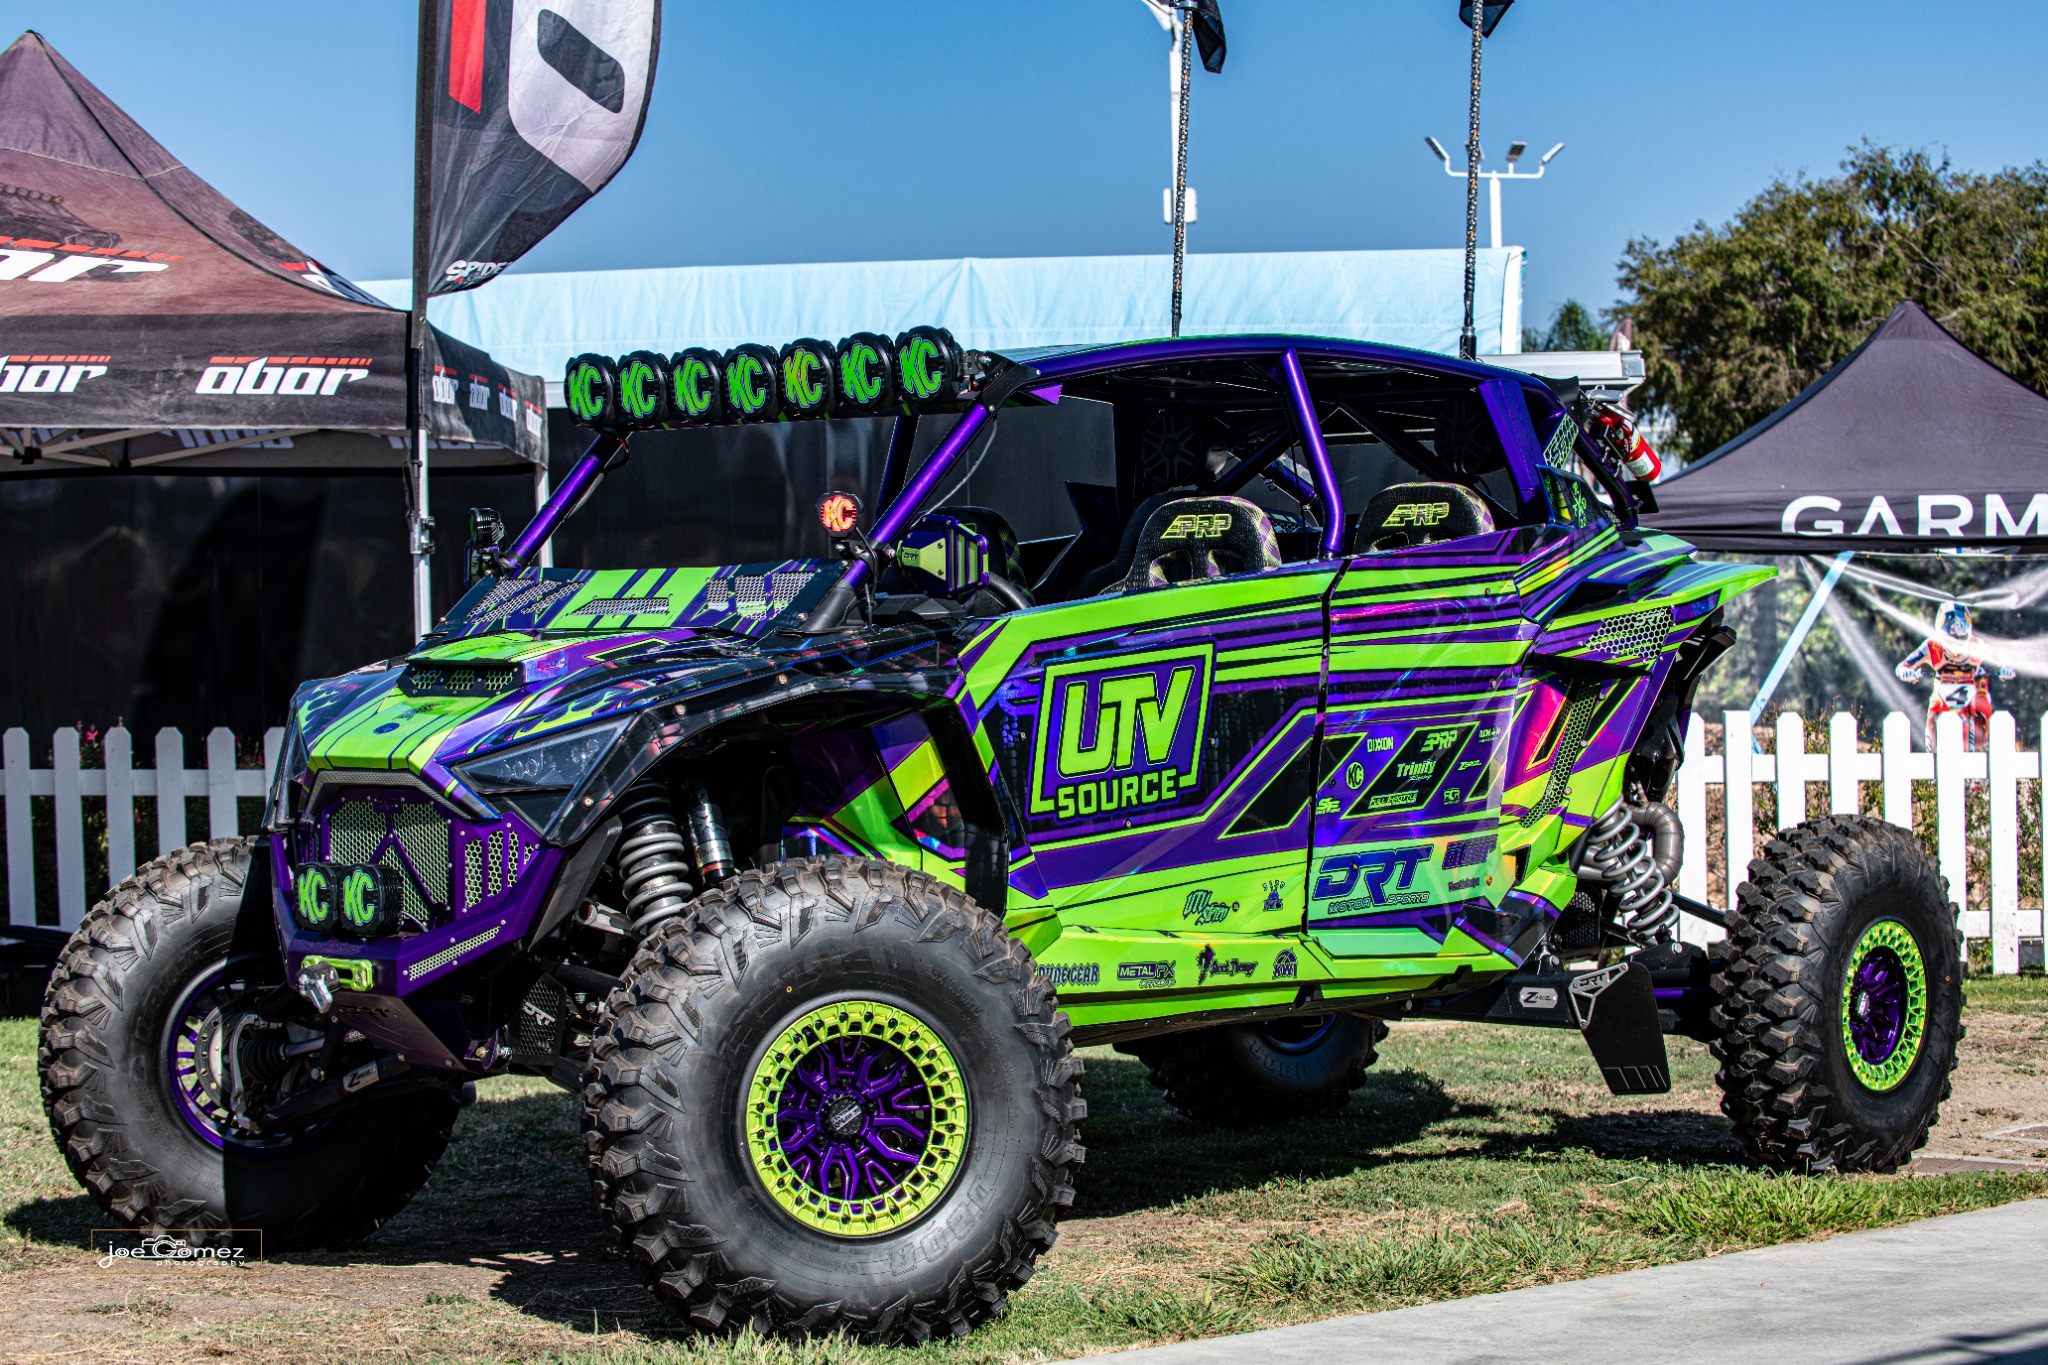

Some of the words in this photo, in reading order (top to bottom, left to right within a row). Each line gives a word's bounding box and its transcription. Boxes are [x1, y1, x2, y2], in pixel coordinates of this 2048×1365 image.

[445, 260, 513, 281] SPIDE
[195, 357, 369, 395] obor
[727, 354, 766, 412] KC
[783, 348, 823, 409] KC
[840, 343, 881, 404] KC
[900, 336, 942, 398] KC
[568, 363, 603, 420] KC
[620, 361, 655, 419] KC
[674, 357, 711, 415] KC
[822, 495, 854, 531] KC
[1160, 513, 1233, 539] PRP
[1381, 502, 1450, 527] PRP
[1781, 493, 2048, 536] GARM
[1945, 685, 1970, 705] 4
[1058, 665, 1196, 778] UTV
[1367, 736, 1394, 753] DIXXON
[1421, 730, 1457, 752] PRP
[1347, 762, 1363, 788] KC
[1397, 760, 1436, 777] Trinity
[1057, 767, 1178, 820] SOURCE
[1313, 845, 1434, 906] DRT
[299, 867, 328, 924] KC
[343, 869, 375, 926] KC
[1328, 897, 1371, 914] MOTOR
[1386, 891, 1430, 905] SPORTS
[1069, 962, 1100, 986] GEAR
[1119, 964, 1156, 978] METAL
[1579, 974, 1606, 987] DRT
